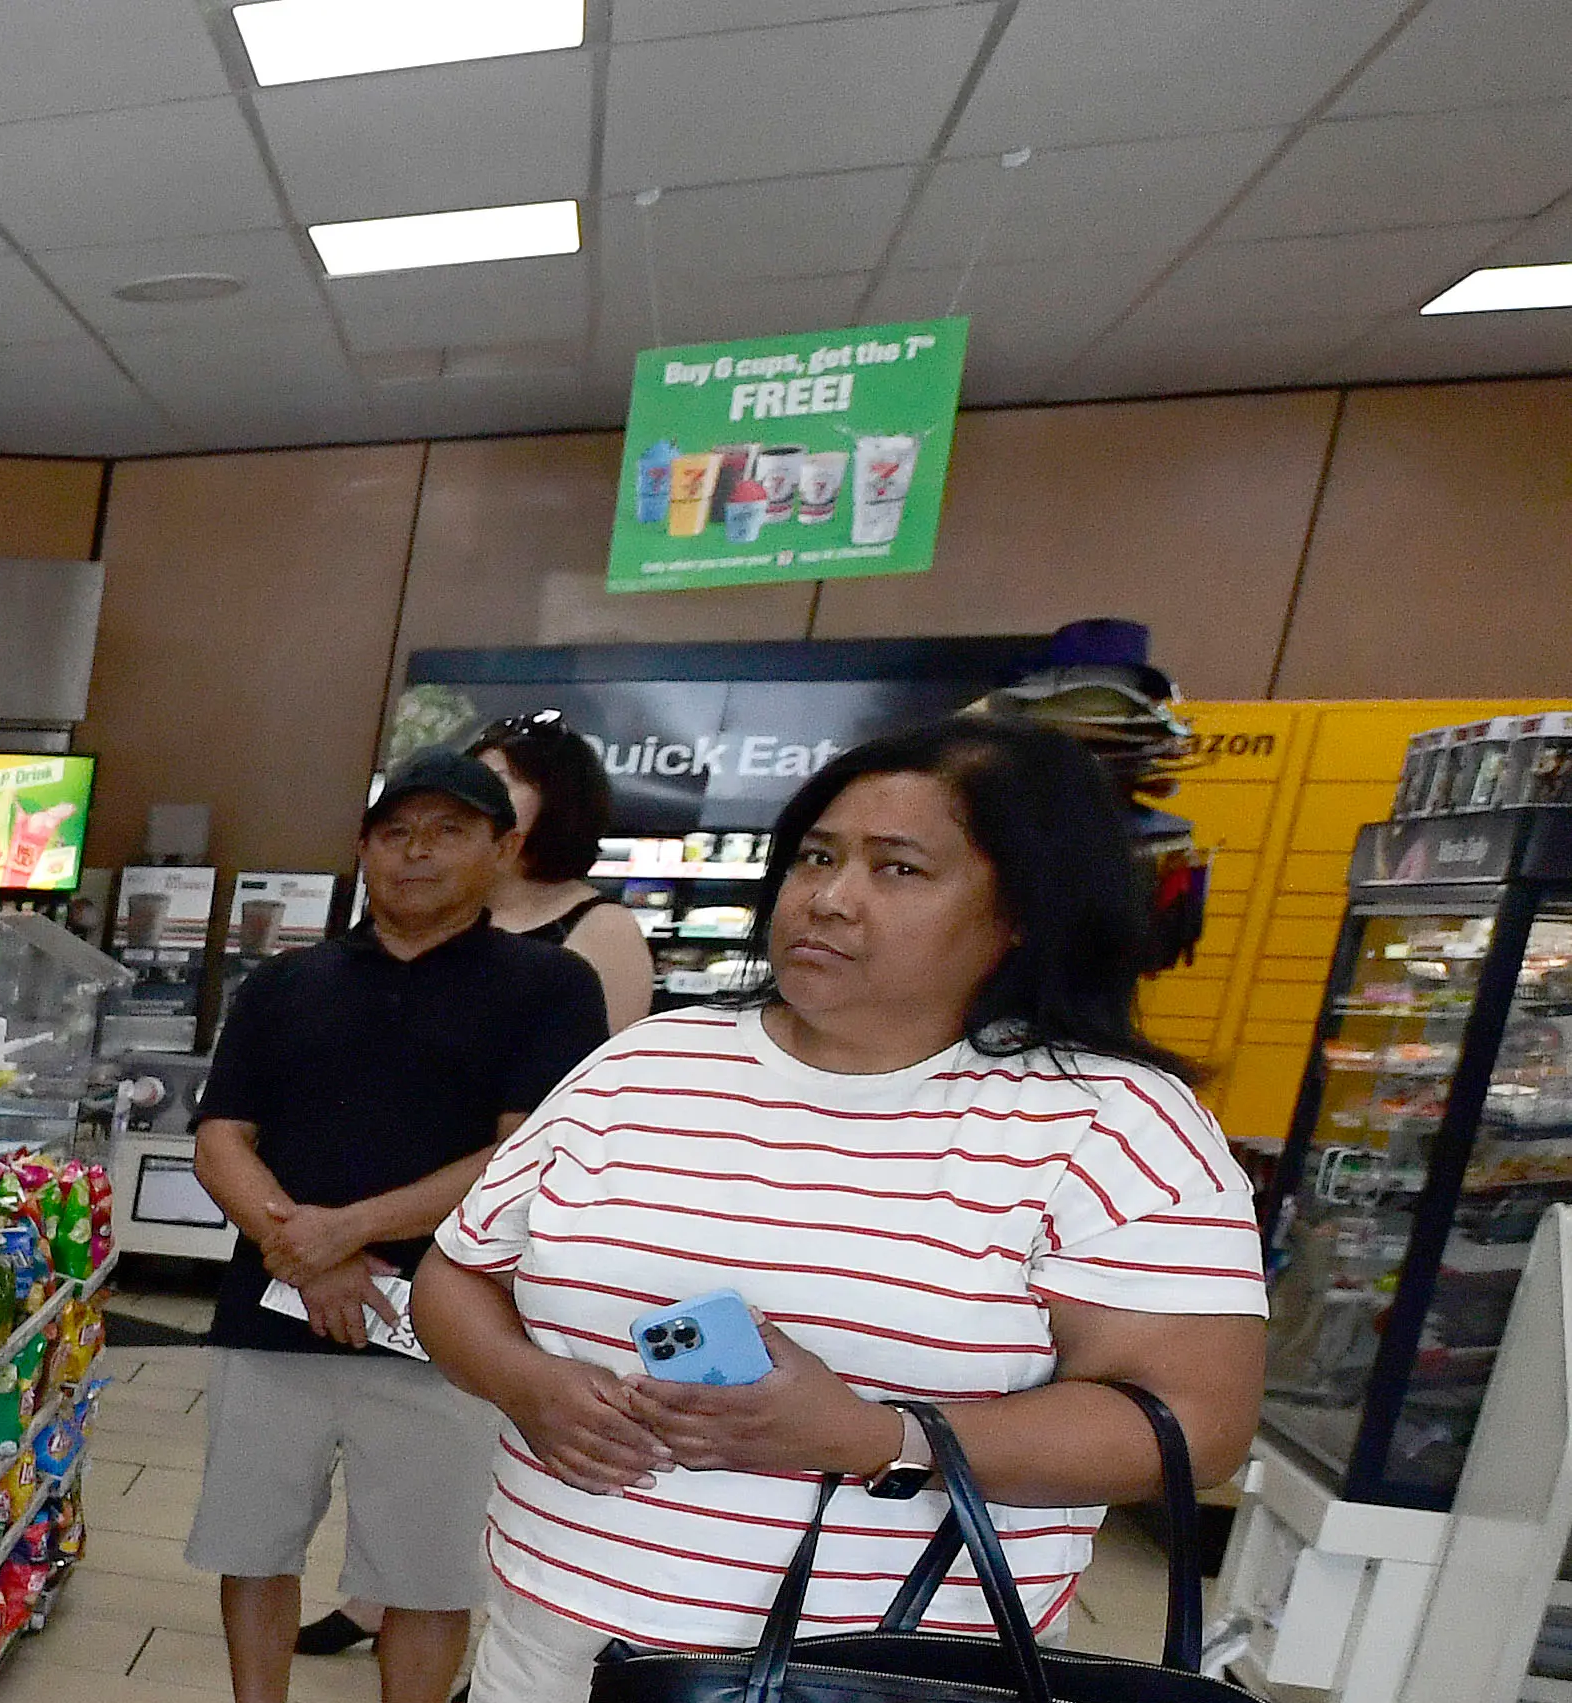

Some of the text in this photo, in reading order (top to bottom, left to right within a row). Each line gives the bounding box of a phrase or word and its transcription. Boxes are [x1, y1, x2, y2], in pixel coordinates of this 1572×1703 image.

[664, 361, 712, 387] Buy
[808, 345, 853, 375] get
[855, 341, 902, 367] the
[728, 373, 856, 422] FREE!
[736, 734, 843, 776] Eat
